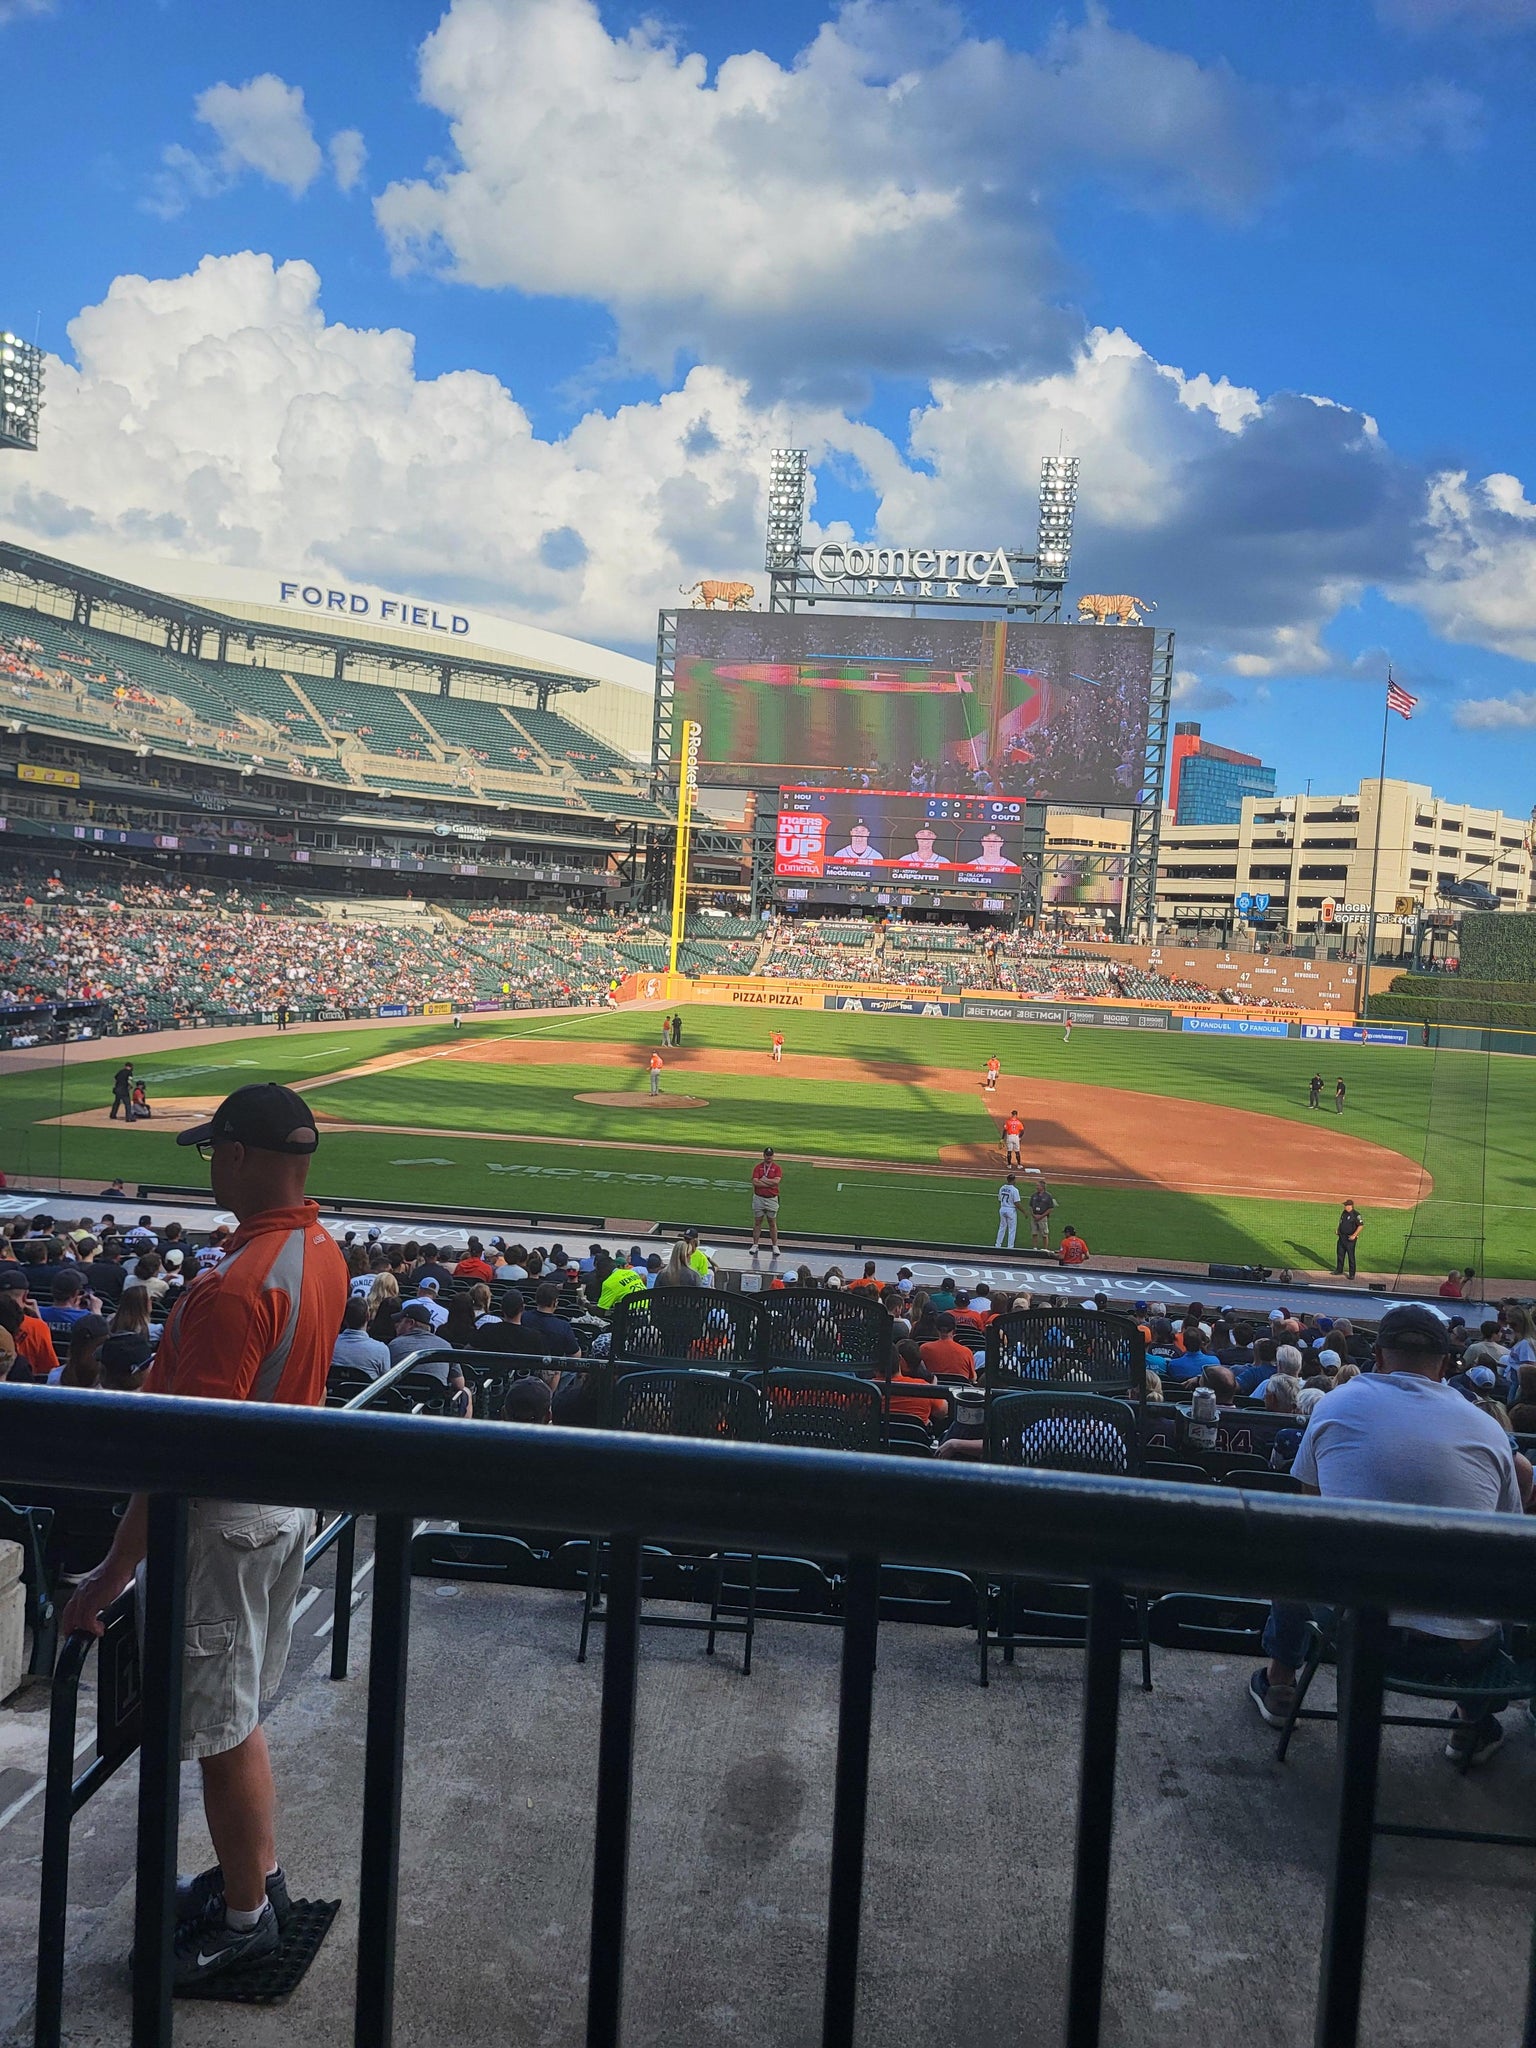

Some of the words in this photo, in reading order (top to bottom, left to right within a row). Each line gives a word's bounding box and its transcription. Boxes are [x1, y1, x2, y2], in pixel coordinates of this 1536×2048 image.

[866, 579, 963, 598] PARK
[279, 582, 370, 616] FORD
[380, 599, 470, 636] FIELD
[992, 802, 1020, 813] 0-0
[780, 816, 823, 825] TIGERS
[779, 824, 822, 839] DUE
[777, 837, 822, 858] UP
[892, 873, 940, 881] CARPENTER
[1335, 903, 1371, 912] BIGGBY
[823, 923, 873, 931] CHEVROLET
[910, 927, 960, 936] CHEVROLET
[1151, 949, 1161, 957] 23
[1225, 953, 1231, 962] 5
[1263, 957, 1269, 966] 2
[1303, 962, 1312, 971] 16
[1347, 967, 1353, 976] 6
[1240, 972, 1250, 981] 47
[1281, 977, 1288, 986] 3
[733, 992, 767, 1004] PIZZA!
[769, 994, 803, 1006] PIZZA!
[974, 1008, 1012, 1018] BETMGM
[1024, 1010, 1062, 1020] BETMGM
[1200, 1021, 1232, 1030] FANDUEL
[1250, 1024, 1281, 1033] FANDUEL
[1305, 1026, 1341, 1040] DTE
[486, 1163, 752, 1188] VICTORS
[1001, 1193, 1010, 1203] 77
